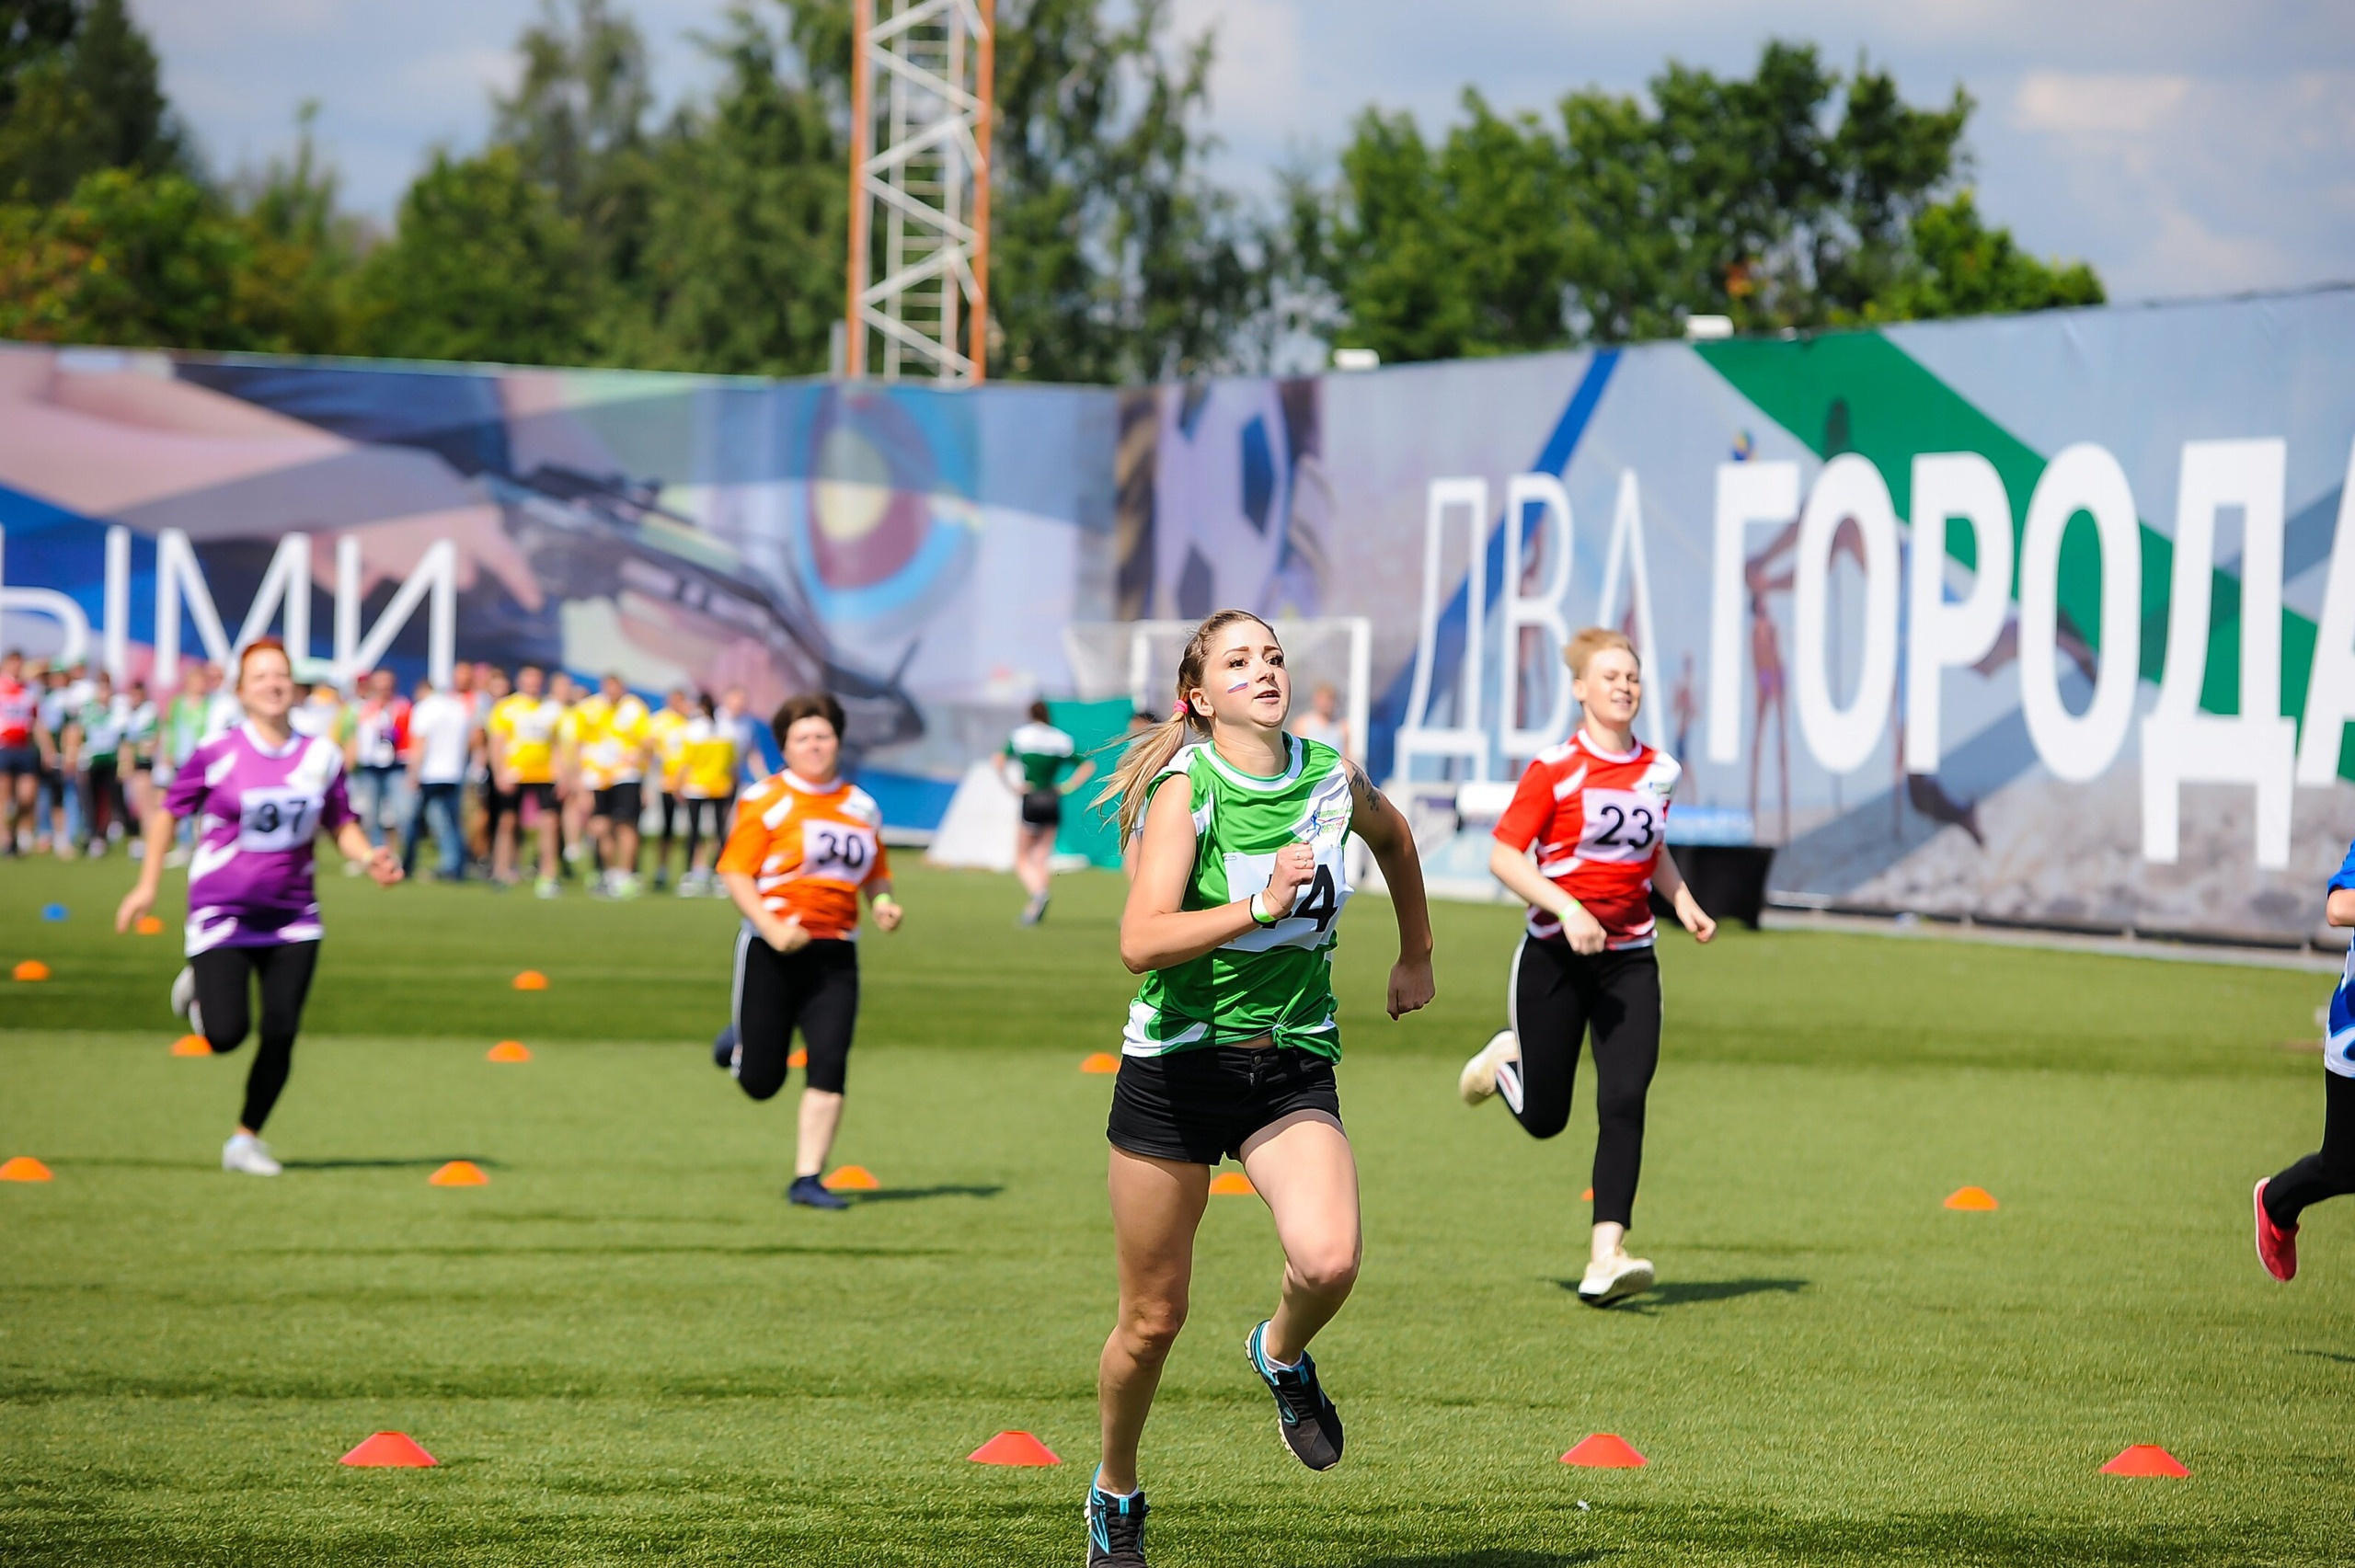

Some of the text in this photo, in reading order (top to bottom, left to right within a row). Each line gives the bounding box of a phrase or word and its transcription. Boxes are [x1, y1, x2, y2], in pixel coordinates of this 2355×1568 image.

[1394, 468, 1668, 782] ДВА
[817, 831, 865, 868] 30
[1594, 806, 1654, 849] 23
[1258, 864, 1338, 933] 4
